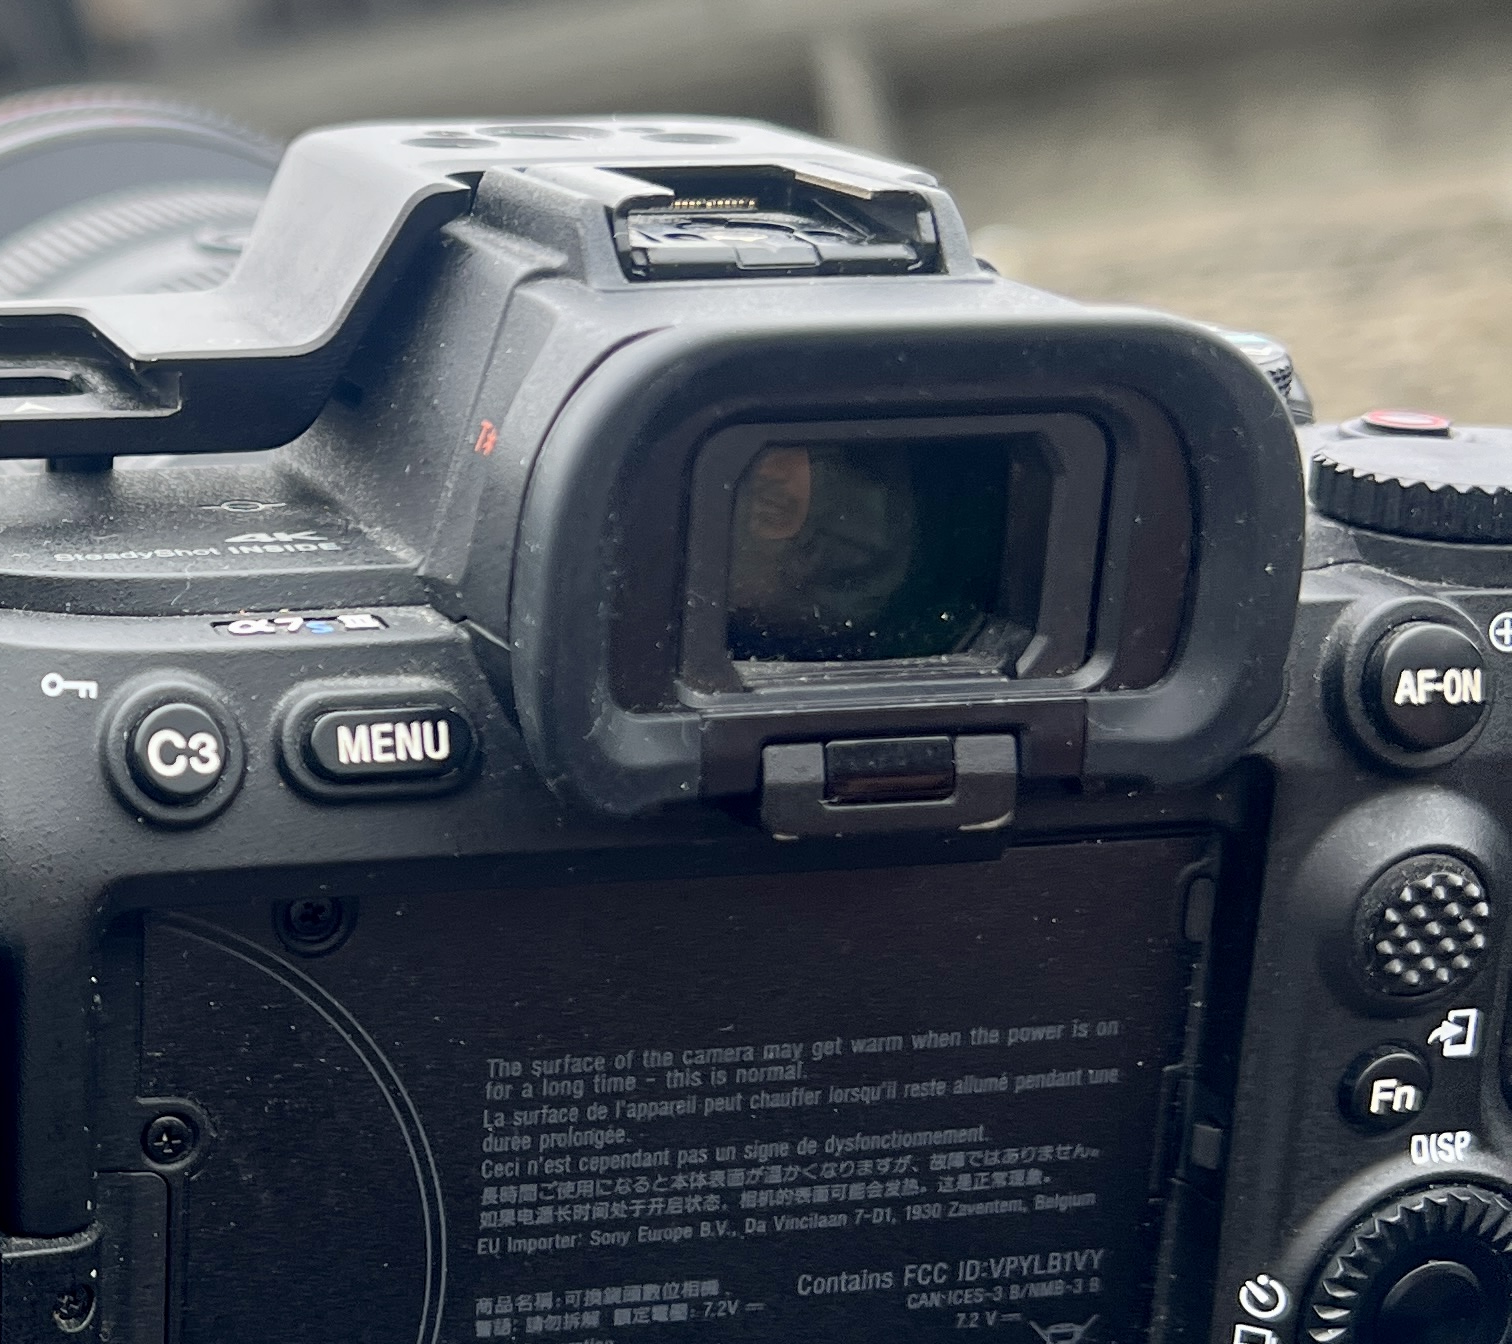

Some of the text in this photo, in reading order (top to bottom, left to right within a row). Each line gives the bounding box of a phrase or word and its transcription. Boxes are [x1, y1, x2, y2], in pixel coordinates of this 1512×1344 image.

[53, 542, 342, 563] SteadyShot INSIDE
[226, 531, 328, 543] 4K
[1395, 668, 1482, 705] AF-ON
[147, 729, 221, 778] C3
[336, 719, 451, 765] MENU
[488, 1019, 1120, 1078] The surface of the camera may get warm when the power is on
[483, 1067, 1120, 1128] La surface de l'appareil peut chauffer lorsqu'il reste allumé pendant une
[486, 1081, 514, 1101] for
[521, 1083, 534, 1099] a
[542, 1077, 585, 1100] long
[593, 1074, 637, 1094] time
[666, 1069, 703, 1089] this
[710, 1066, 727, 1086] is
[736, 1060, 808, 1084] normal.
[1369, 1078, 1417, 1114] Fn
[481, 1158, 520, 1180] Ceci
[527, 1155, 572, 1176] n'est
[578, 1148, 669, 1173] cependant
[676, 1147, 709, 1169] pas
[715, 1144, 736, 1162] un
[744, 1139, 789, 1163] signe
[796, 1136, 818, 1156] de
[1410, 1130, 1472, 1164] DISP
[477, 1236, 501, 1256] EU
[507, 1232, 583, 1256] Importer:
[589, 1229, 631, 1248] Sony
[637, 1221, 694, 1244] Europe
[744, 1217, 768, 1234] Da
[773, 1212, 848, 1232] Vincilaan
[904, 1202, 942, 1222] 1930
[1033, 1190, 1097, 1213] Belgium
[796, 1268, 895, 1297] Contains
[903, 1261, 949, 1288] FCC
[703, 1299, 740, 1318] 7.2V
[906, 1291, 943, 1309] CAN
